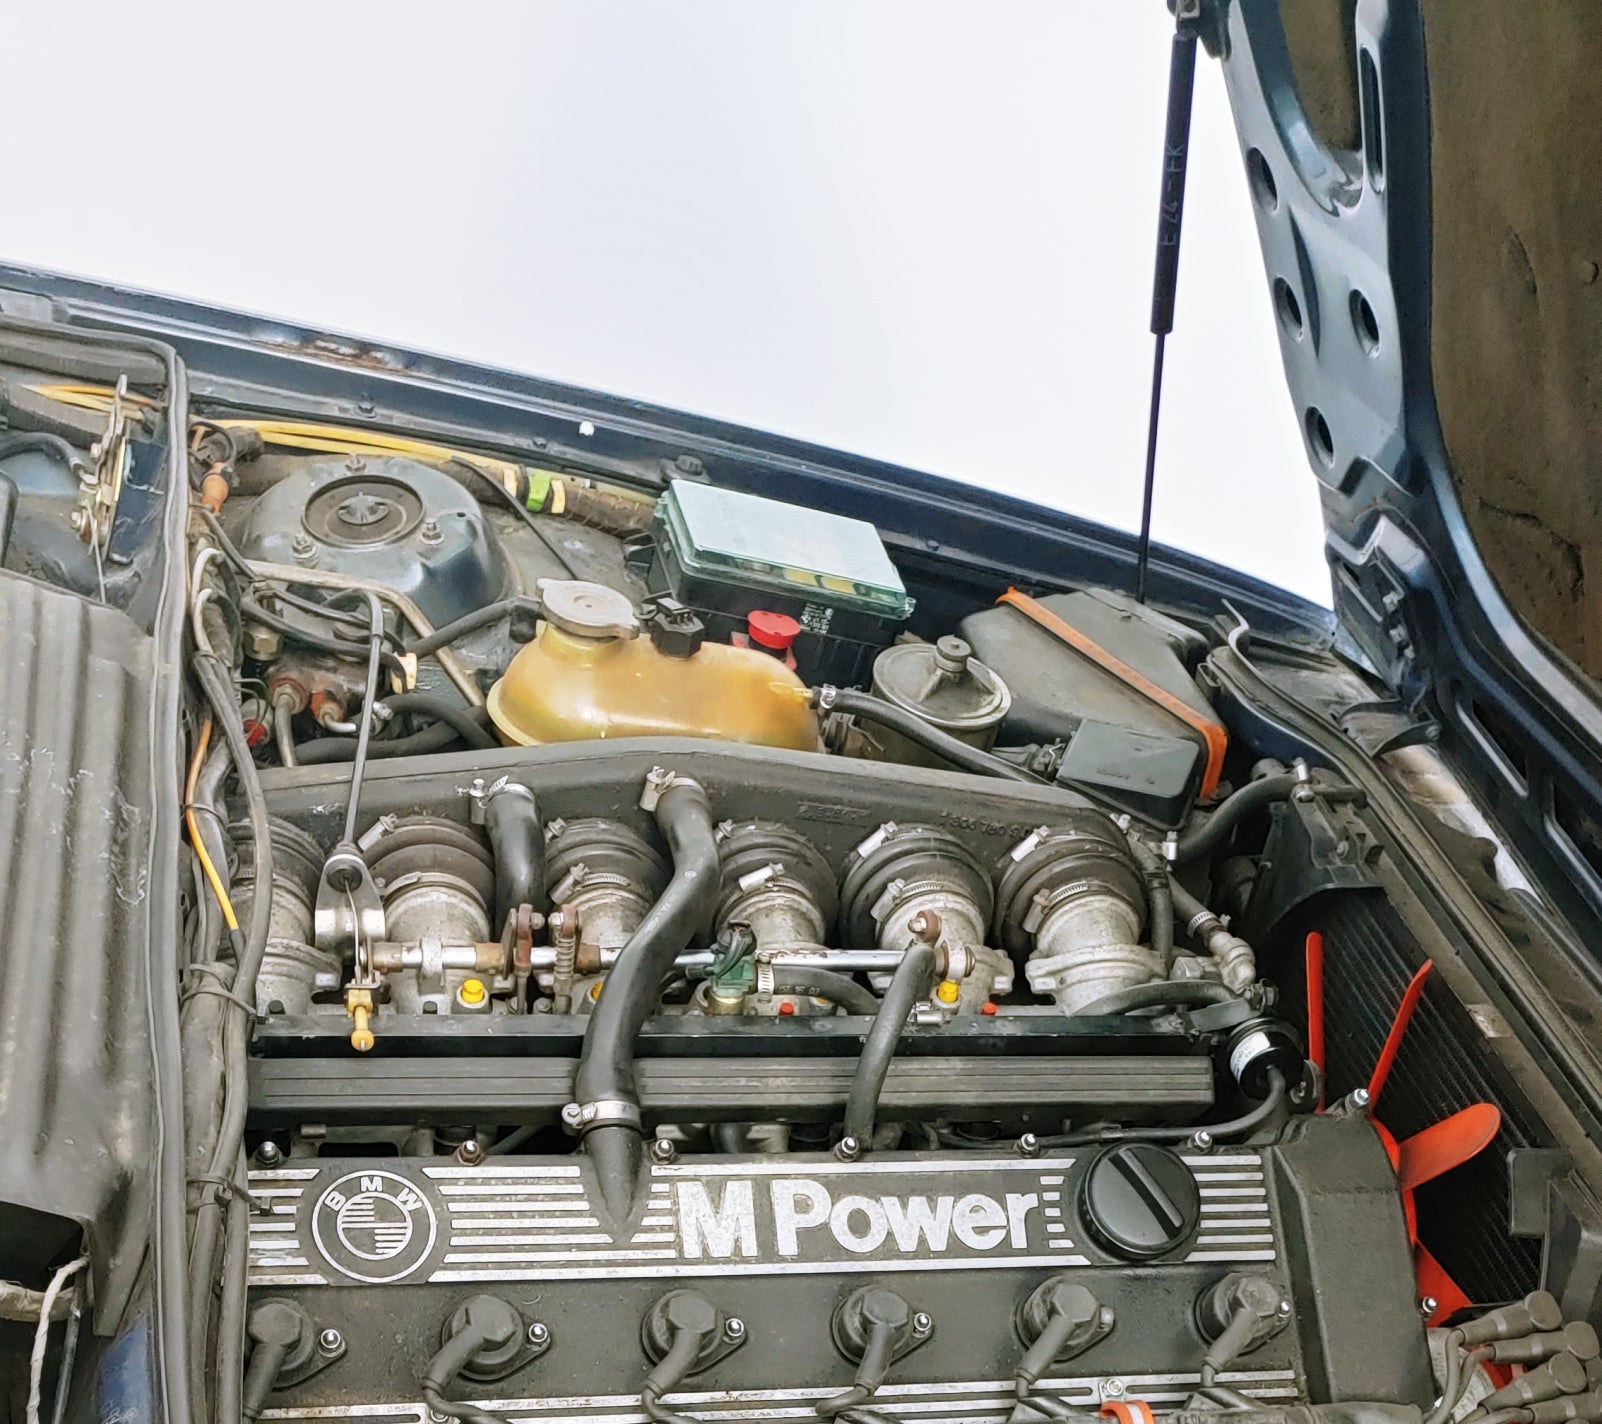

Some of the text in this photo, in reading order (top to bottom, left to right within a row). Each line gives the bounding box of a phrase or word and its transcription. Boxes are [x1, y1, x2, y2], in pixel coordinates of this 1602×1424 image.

[324, 1176, 423, 1212] BMW
[676, 1178, 1039, 1259] M Power
